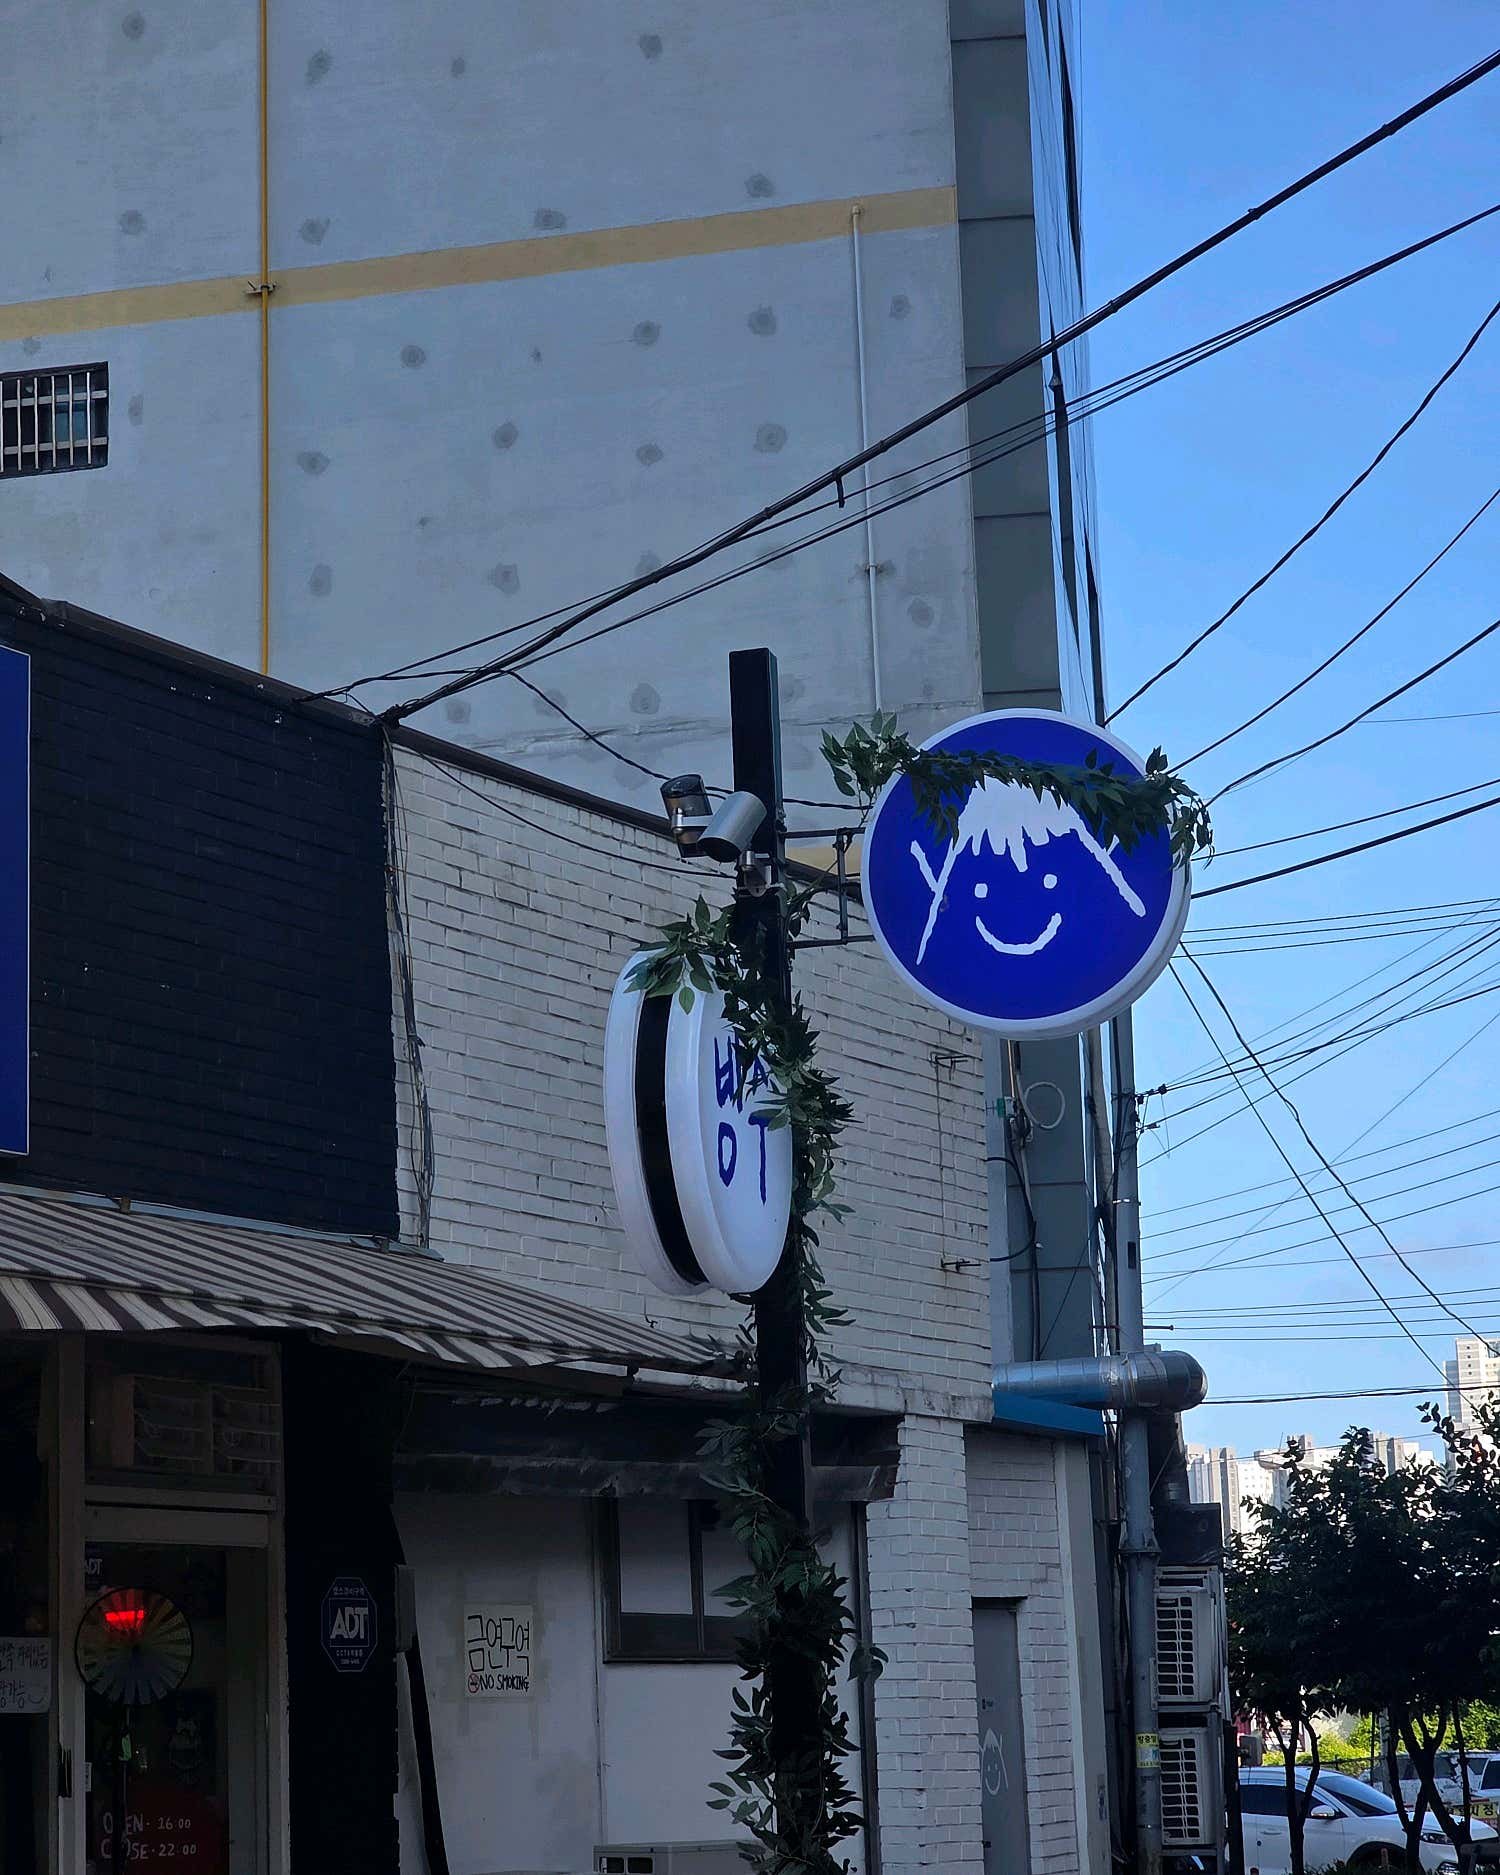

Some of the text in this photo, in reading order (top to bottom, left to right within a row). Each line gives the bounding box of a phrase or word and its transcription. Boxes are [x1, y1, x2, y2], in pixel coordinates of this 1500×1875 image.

[330, 1606, 368, 1640] ADT
[467, 1614, 530, 1677] 금연구역
[479, 1673, 530, 1693] NO SMOKING
[103, 1811, 144, 1835] OEN
[100, 1838, 149, 1861] COSE
